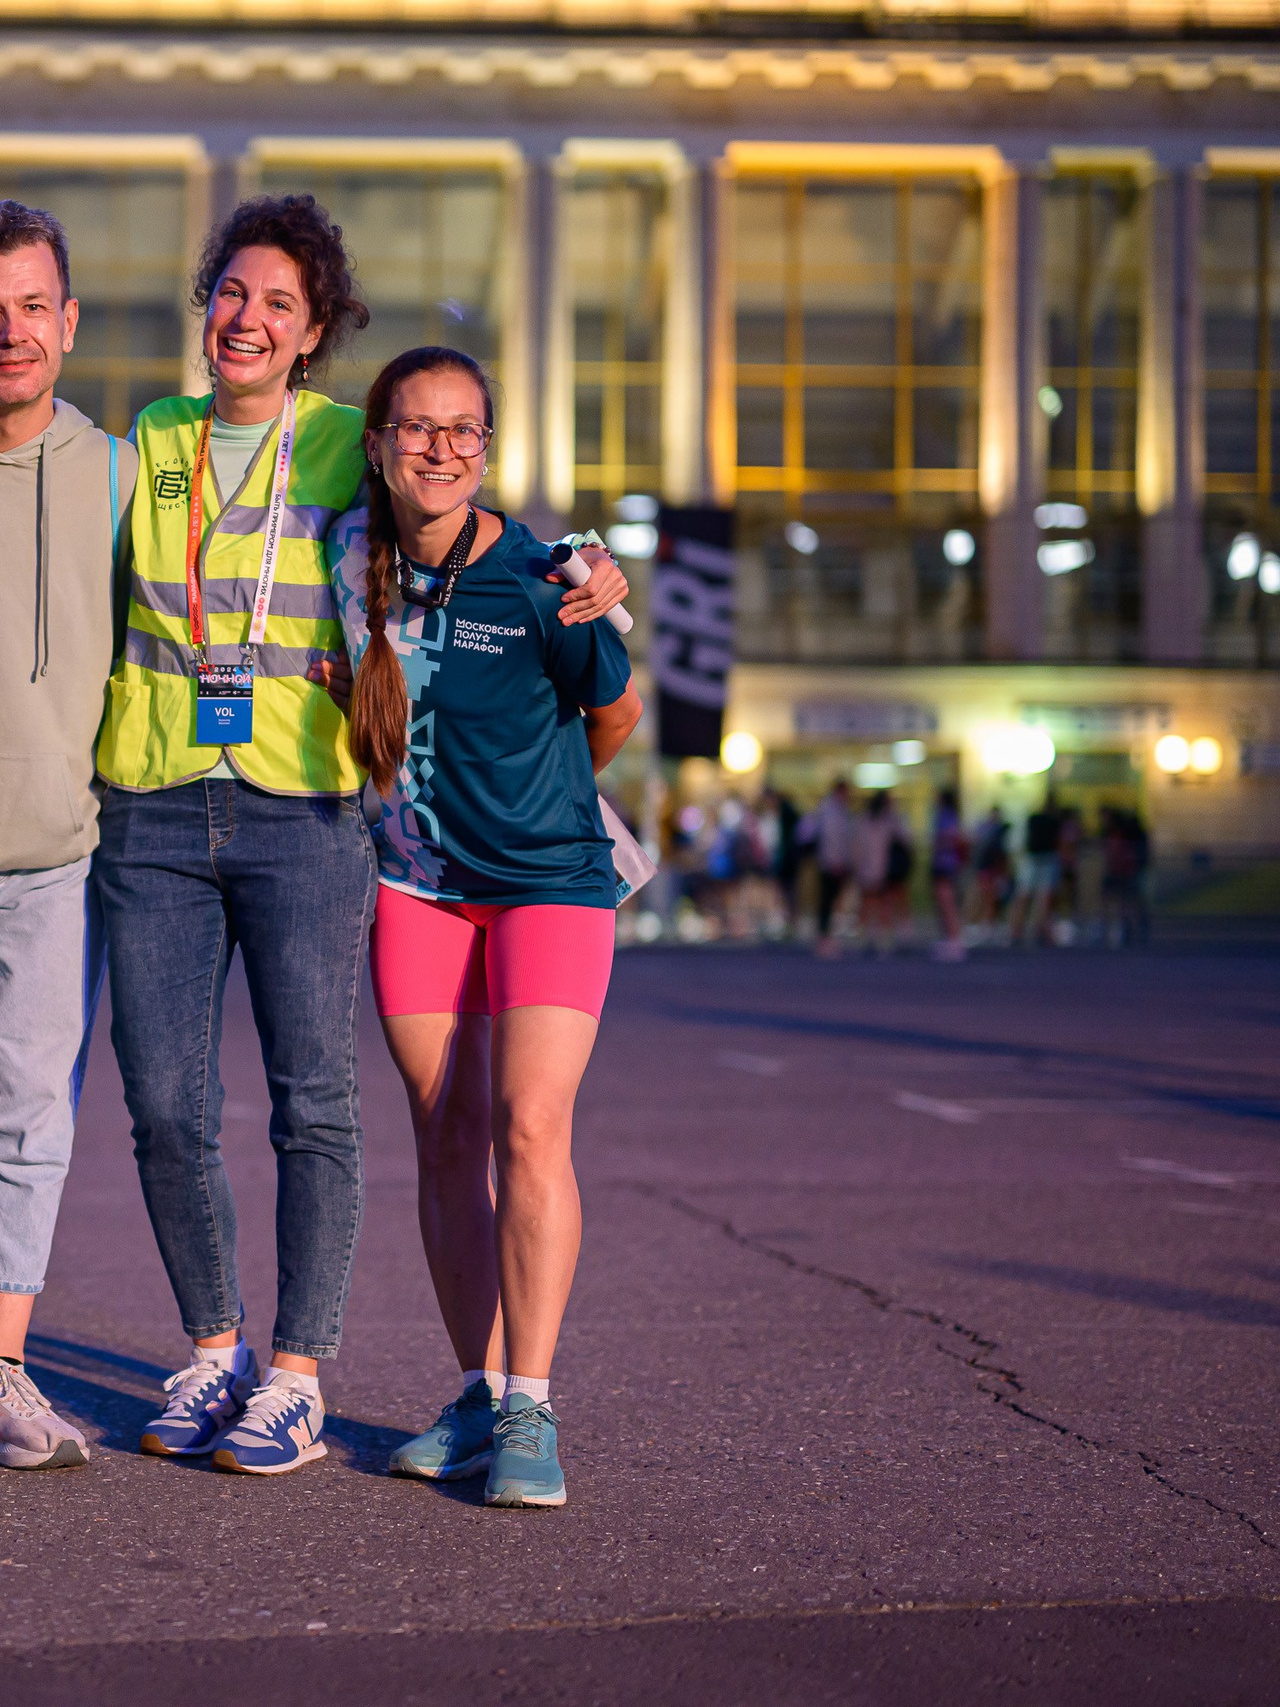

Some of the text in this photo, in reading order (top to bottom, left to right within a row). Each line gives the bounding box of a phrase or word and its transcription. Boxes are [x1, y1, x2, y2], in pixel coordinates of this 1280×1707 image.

[283, 431, 290, 439] 10
[282, 440, 290, 452] ЛЕТ
[192, 529, 198, 537] 10
[268, 511, 280, 549] ПРИМЕРОМ
[265, 549, 273, 565] ДЛЯ
[260, 566, 270, 596] МНОГИХ
[455, 617, 526, 637] МОСКОВСКИЙ
[454, 629, 482, 642] ПОЛУ
[453, 639, 503, 654] МАРАФОН
[215, 707, 235, 717] VOL
